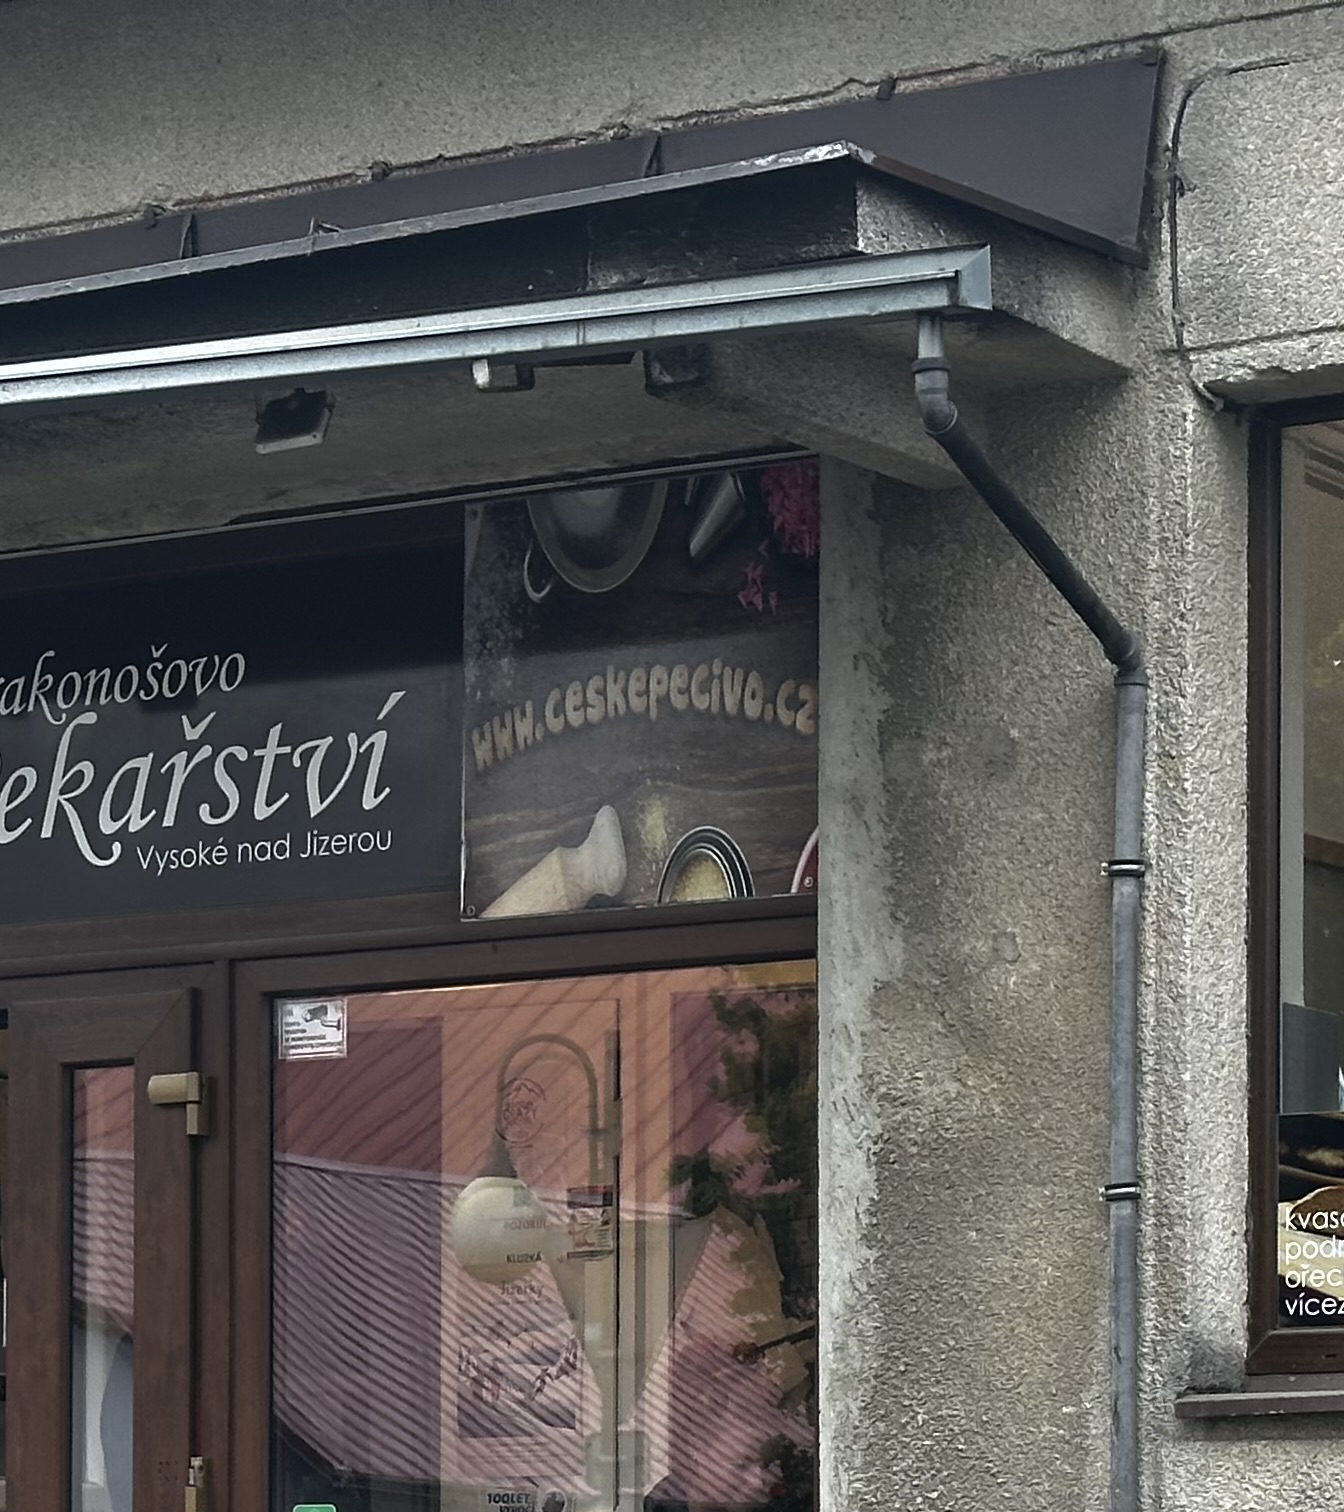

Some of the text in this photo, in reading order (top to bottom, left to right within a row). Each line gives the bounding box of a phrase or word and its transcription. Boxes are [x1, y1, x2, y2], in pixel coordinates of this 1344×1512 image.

[471, 658, 816, 771] www.ceskepecivo.cz
[136, 827, 393, 875] Vysoké nad Jizerou
